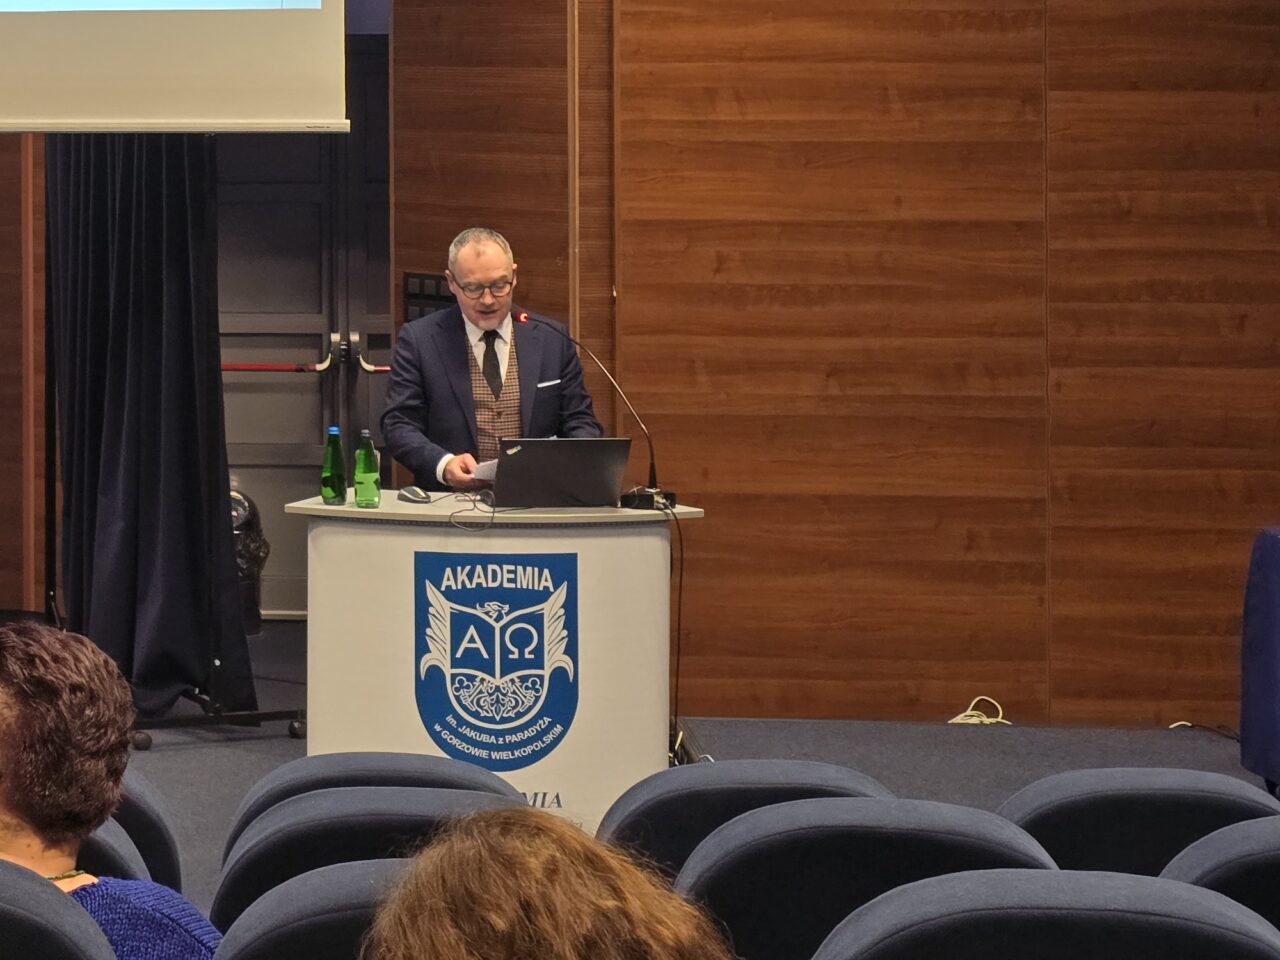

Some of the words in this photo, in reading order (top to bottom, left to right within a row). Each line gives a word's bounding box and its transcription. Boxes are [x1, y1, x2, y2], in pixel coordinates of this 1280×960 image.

[441, 564, 554, 592] AKADEMIA
[441, 731, 489, 758] GORZOWIE
[491, 724, 564, 760] WIELKOPOLSKIM
[458, 725, 497, 744] JAKUBA
[505, 716, 552, 743] PARADYŻA
